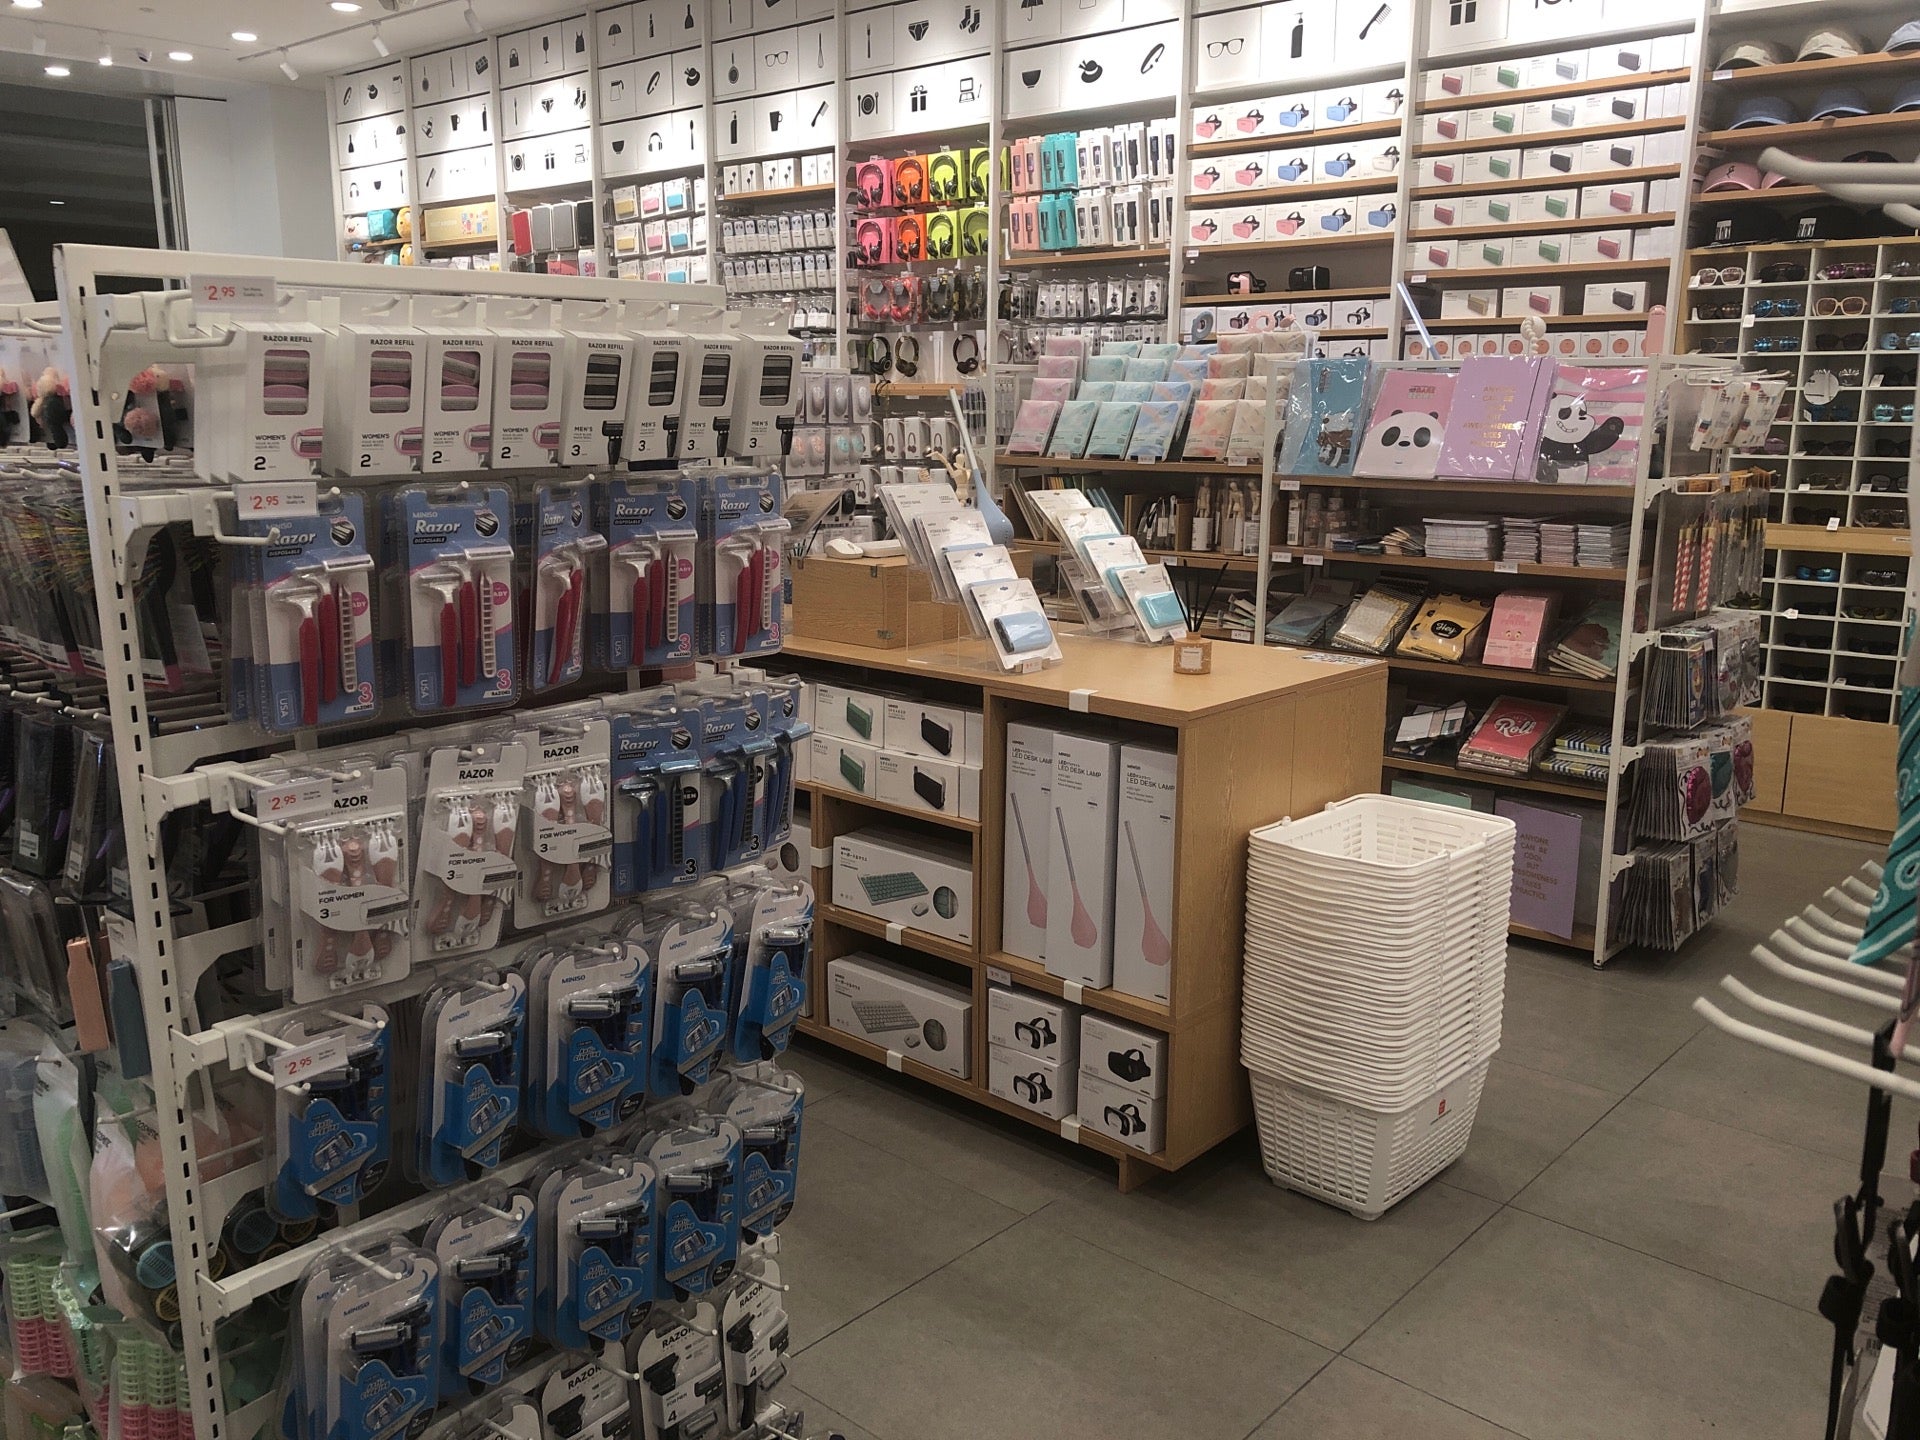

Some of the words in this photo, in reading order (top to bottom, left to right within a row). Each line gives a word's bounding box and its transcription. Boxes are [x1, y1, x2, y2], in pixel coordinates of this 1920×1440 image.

[638, 440, 646, 451] 3
[687, 439, 695, 450] 3
[749, 438, 757, 448] 3
[501, 446, 511, 458] 2
[571, 444, 580, 456] 3
[360, 454, 371, 467] 2
[432, 451, 442, 463] 2
[254, 456, 266, 471] 2
[616, 504, 654, 516] Razor
[720, 500, 750, 511] Razor
[543, 513, 565, 526] Razor
[415, 519, 461, 534] Razor
[769, 623, 779, 640] 3
[1436, 622, 1456, 635] Hey
[678, 634, 691, 651] 3
[497, 669, 511, 689] 3
[359, 682, 372, 703] 3
[420, 679, 429, 698] USA
[279, 698, 288, 718] USA
[705, 723, 734, 733] Razor
[1494, 718, 1536, 737] Roll
[620, 739, 659, 751] Razor
[544, 745, 579, 758] RAZOR
[458, 768, 494, 780] RAZOR
[1058, 764, 1069, 772] LED
[1070, 766, 1085, 774] DESK
[1086, 769, 1101, 777] LAMP
[1140, 780, 1157, 788] DESK
[1158, 783, 1175, 791] LAMP
[334, 795, 368, 808] AZOR
[751, 835, 760, 850] 3
[1520, 833, 1549, 845] ANYONE
[540, 844, 548, 852] 3
[1524, 852, 1542, 862] COOL
[685, 859, 696, 874] 3
[447, 870, 455, 880] 3
[335, 892, 364, 901] WOMEN
[320, 909, 330, 919] 3
[561, 974, 585, 984] MINISO
[659, 1151, 682, 1160] MINISO
[570, 1194, 593, 1205] MINISO
[739, 1284, 763, 1308] RAZOR
[343, 1302, 370, 1316] MINISO
[750, 1366, 757, 1378] 4
[668, 1411, 677, 1423] 4
